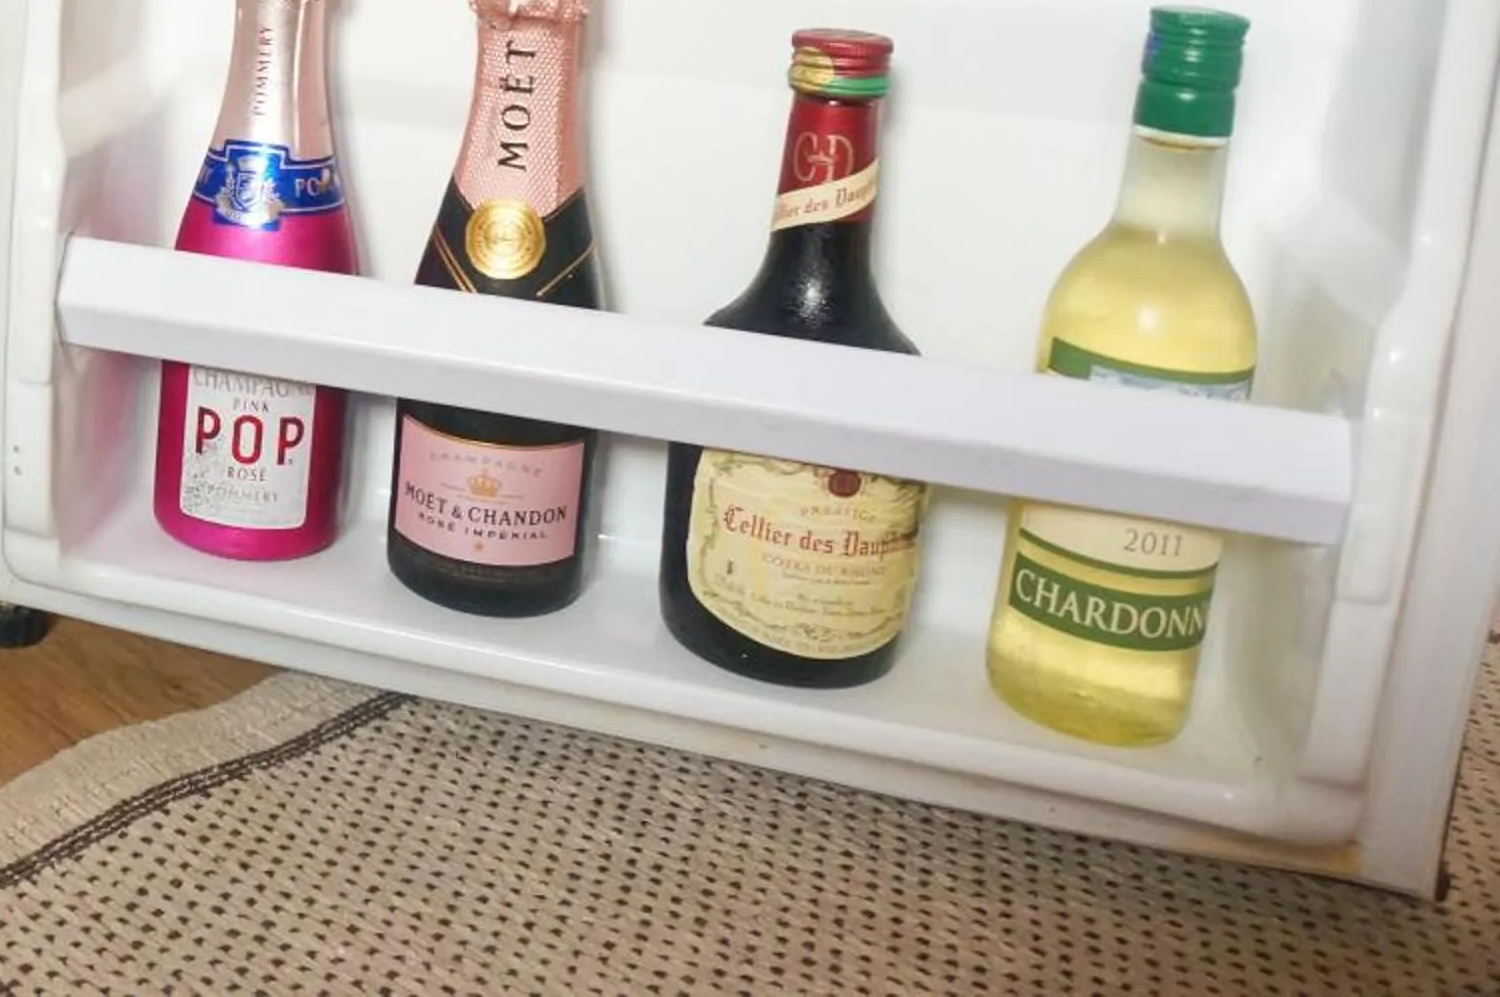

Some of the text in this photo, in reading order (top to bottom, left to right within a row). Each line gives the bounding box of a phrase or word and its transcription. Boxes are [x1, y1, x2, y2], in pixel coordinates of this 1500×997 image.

[196, 406, 305, 466] POP
[451, 507, 463, 520] &
[467, 505, 568, 527] CHANDON
[723, 505, 792, 547] Cellier
[799, 531, 834, 554] des
[1123, 528, 1184, 556] 2011
[1015, 568, 1204, 638] CHARDONN
